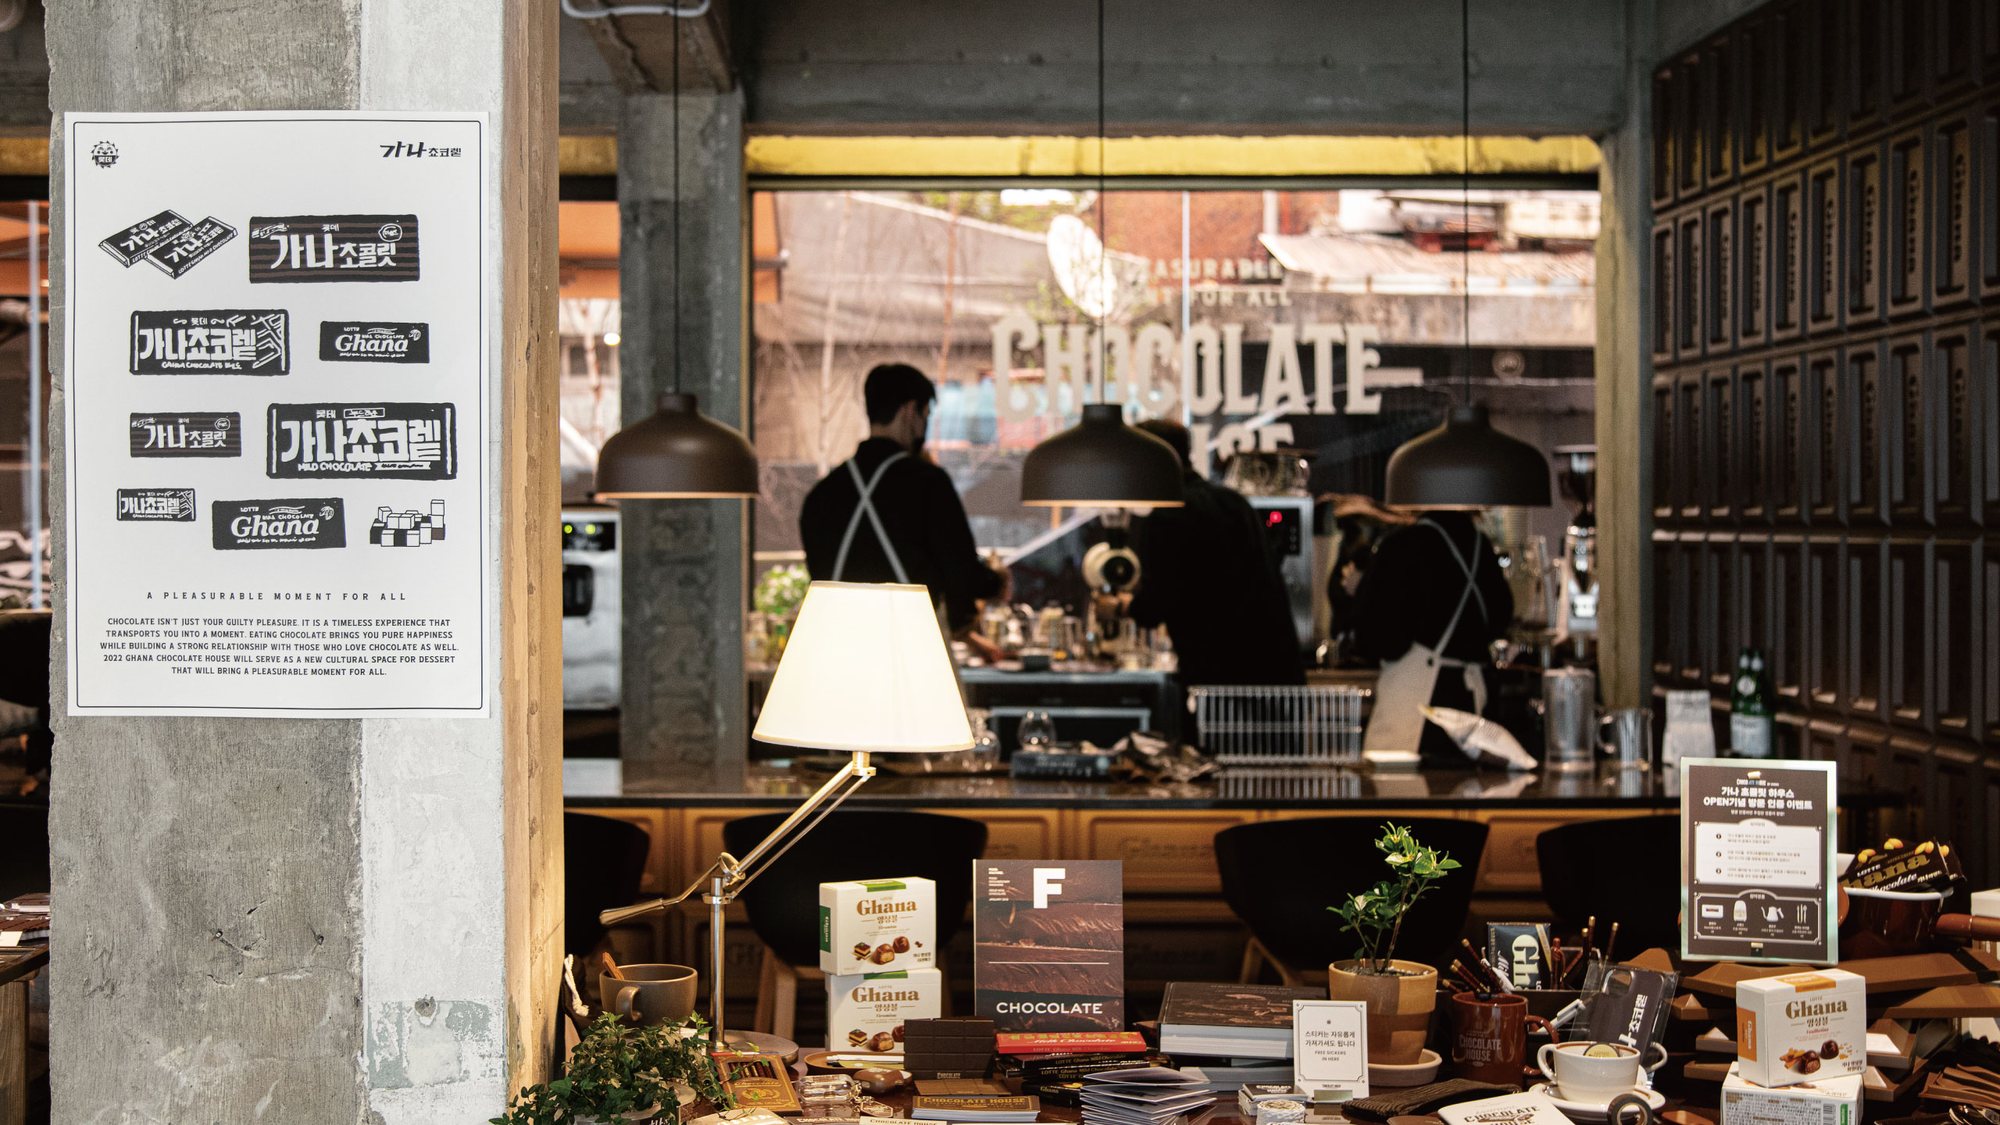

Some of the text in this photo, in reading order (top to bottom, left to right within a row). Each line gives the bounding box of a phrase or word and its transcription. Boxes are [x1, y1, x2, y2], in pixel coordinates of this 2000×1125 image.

[335, 333, 409, 352] Ghana
[992, 314, 1382, 422] CHOCOLATE
[231, 514, 320, 538] Ghana
[146, 591, 406, 601] A PLEASURABLE MOMENT FOR ALL
[107, 617, 451, 627] CHOCOLATE ISN'T JUST YOUR GUILTY PLEASURE. IT IS A TIMELESS EXPERIENCE THAT
[105, 629, 453, 639] TRANSPORTS YOU INTO A MOMENT. EATING CHOCOLATE BRINGS YOU PURE HAPPINESS
[99, 642, 459, 652] WHILE BUILDING A STRONG RELATIONSHIP WITH THOSE WHO LOVE CHOCOLATE AS WELL.
[103, 654, 456, 664] 2022 GHANA CHOCOLATE HOUSE WILL SERVE AS A NEW CULTURAL SPACE FOR DESSERT
[171, 666, 387, 676] THAT WILL BRING A PLEASURABLE MOMENT FOR ALL.
[1840, 853, 1931, 889] hana
[1033, 867, 1066, 909] F
[856, 898, 918, 916] Ghana
[851, 985, 920, 1003] Ghana
[995, 1001, 1103, 1014] CHOCOLATE
[1785, 999, 1848, 1020] Ghana
[1337, 1040, 1355, 1048] 됩니다
[923, 1096, 984, 1104] CHOCOLATE
